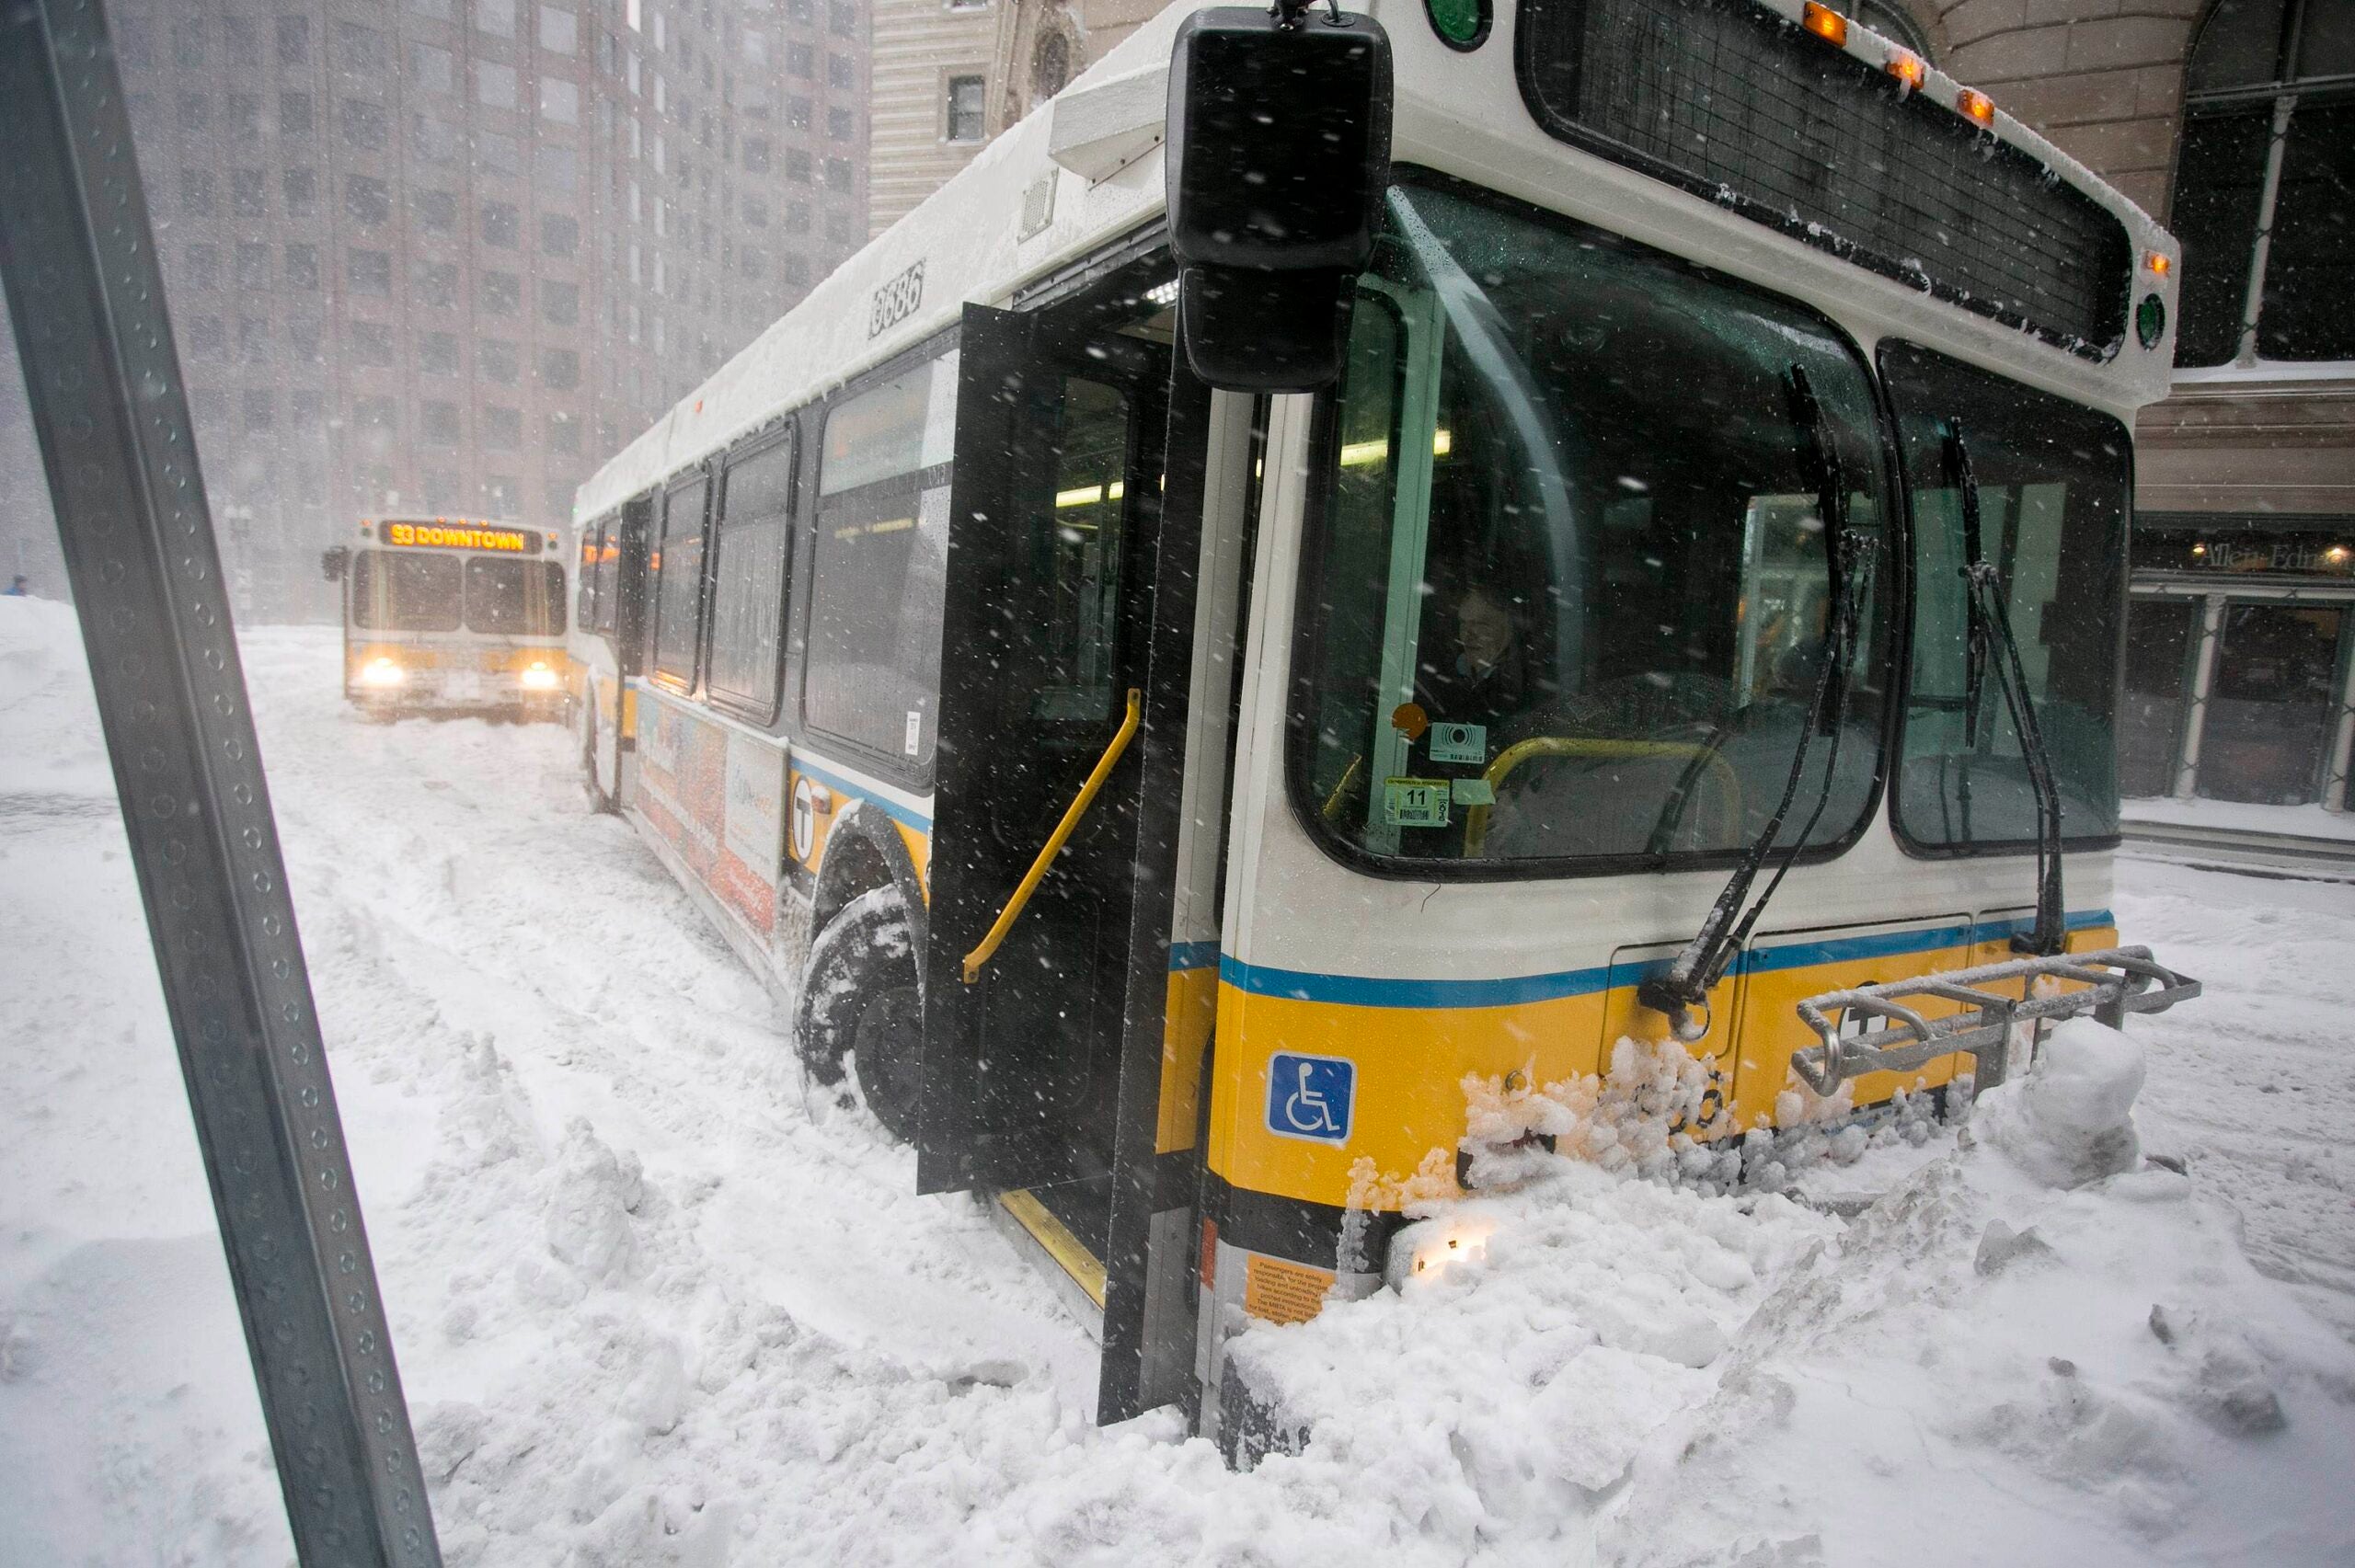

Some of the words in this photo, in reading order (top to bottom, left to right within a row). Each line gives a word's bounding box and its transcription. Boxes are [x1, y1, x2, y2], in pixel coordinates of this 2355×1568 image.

[416, 526, 524, 551] DOWNTOWN
[1407, 790, 1425, 806] 11
[796, 796, 811, 849] T
